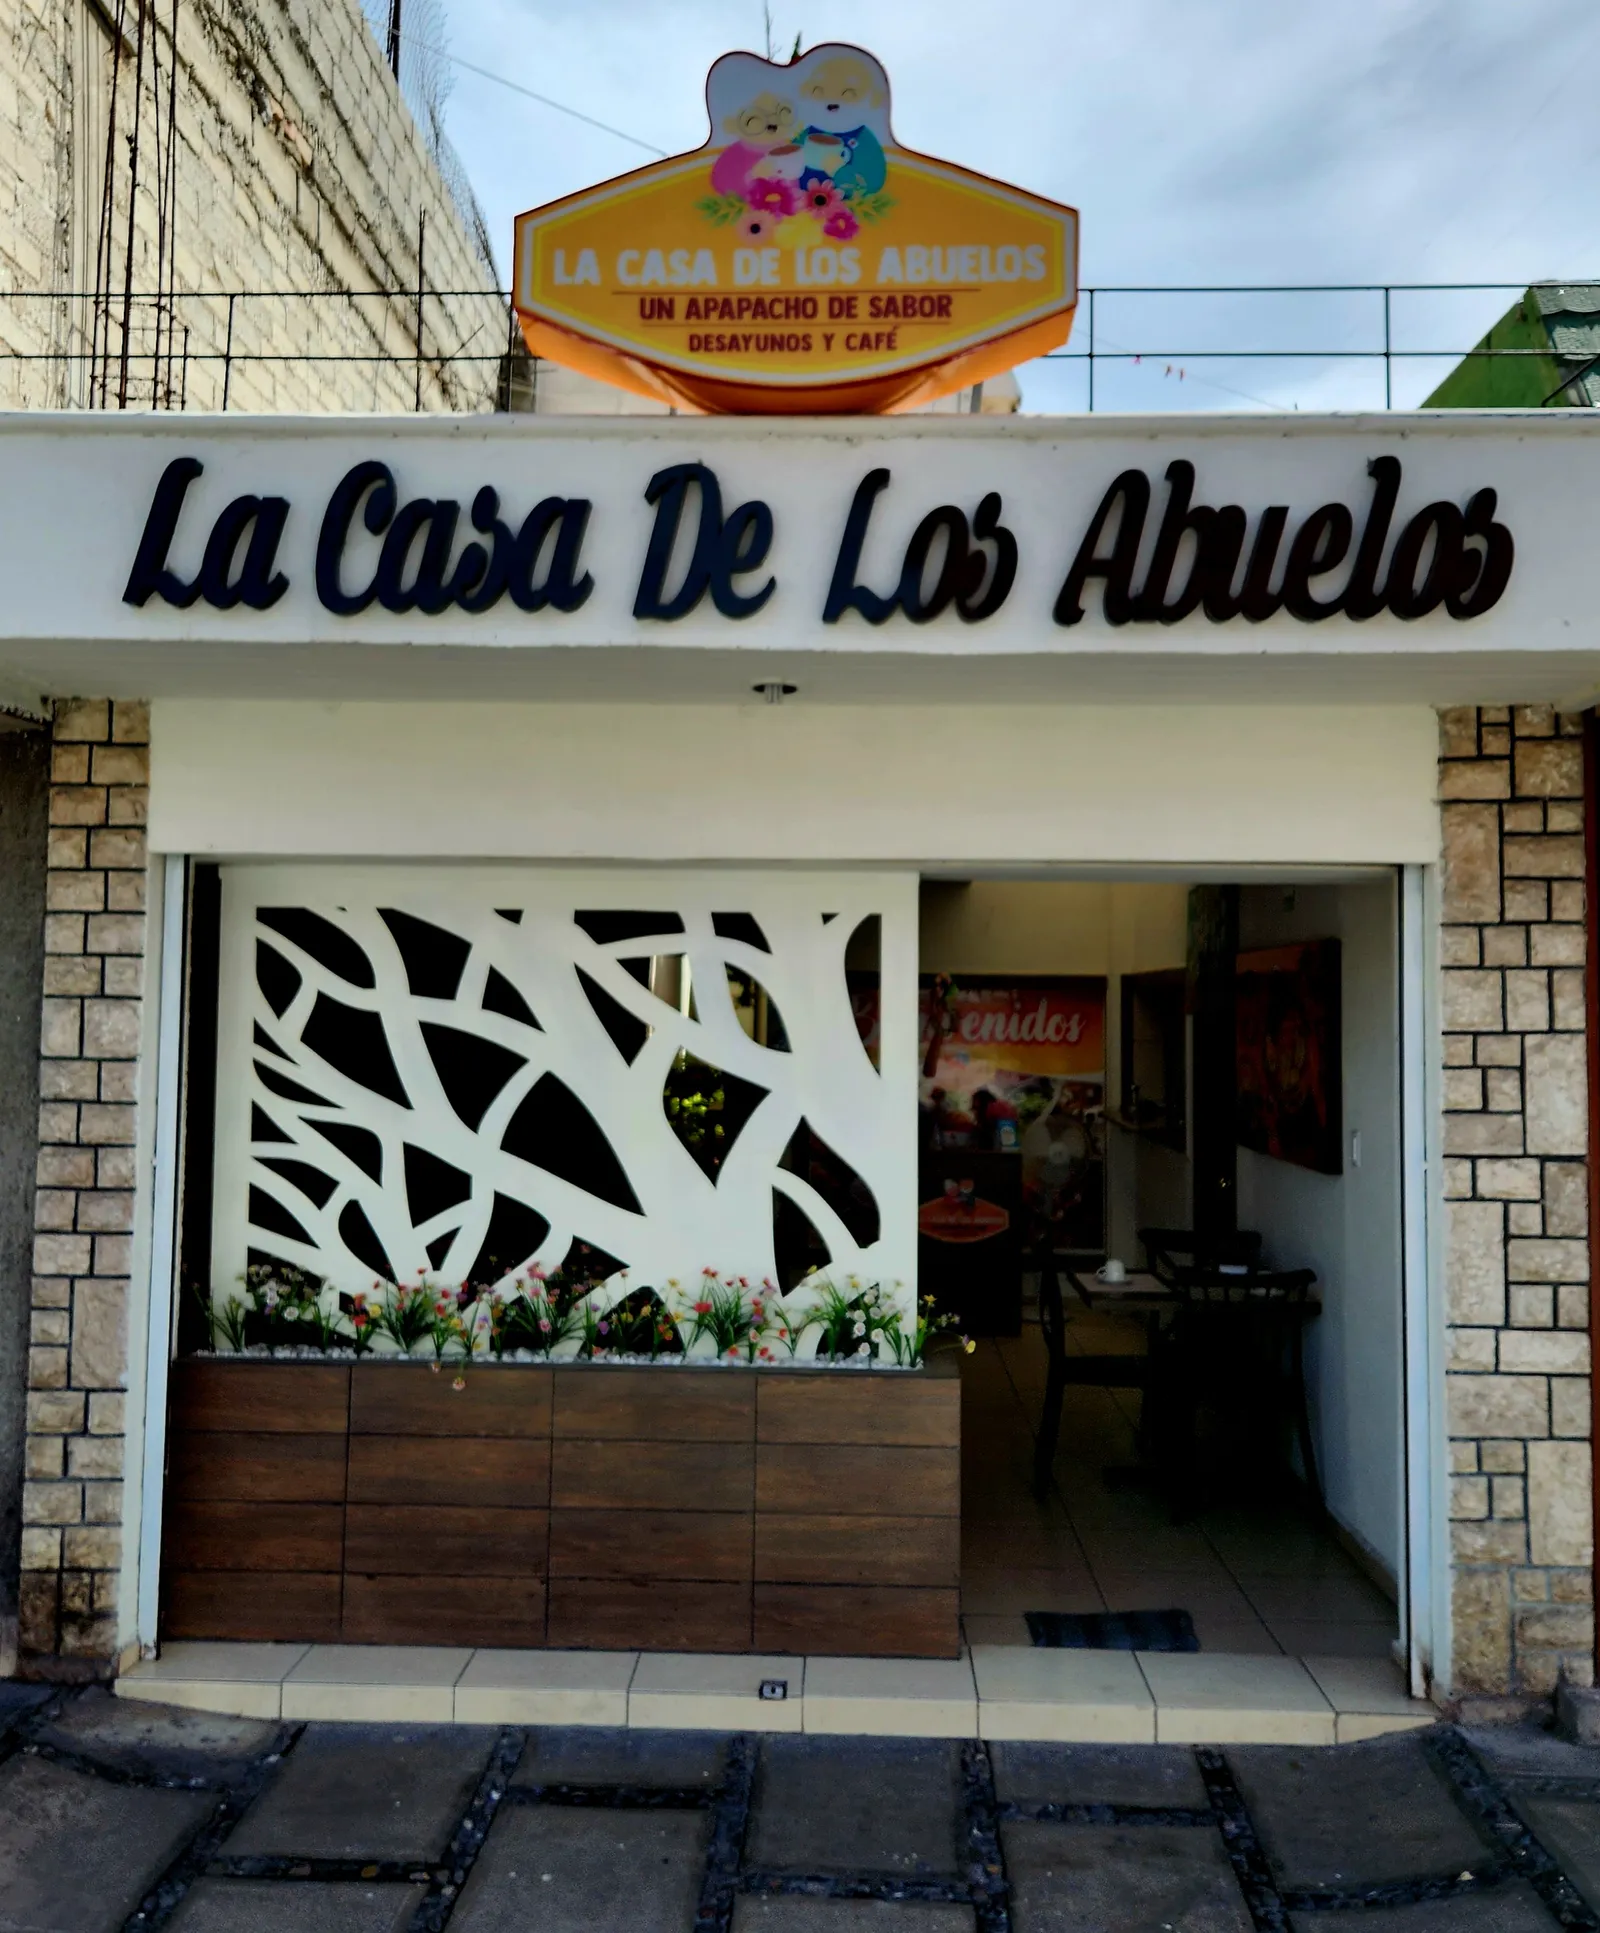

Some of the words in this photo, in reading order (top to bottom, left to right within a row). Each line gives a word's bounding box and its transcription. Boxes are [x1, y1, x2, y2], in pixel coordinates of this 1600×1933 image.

[553, 247, 602, 286] LA
[616, 247, 718, 286] CASA
[732, 247, 781, 286] DE
[794, 245, 862, 285] LOS
[876, 243, 1047, 284] ABUELOS
[639, 297, 675, 321] UN
[685, 296, 818, 321] APAPACHO
[828, 296, 859, 320] DE
[869, 294, 953, 319] SABOR
[688, 333, 813, 353] DESAYUNOS
[823, 333, 835, 352] Y
[845, 323, 899, 351] CAFÉ
[122, 456, 291, 610] La
[315, 460, 595, 616] Casa
[633, 460, 777, 621] De
[822, 467, 1018, 624] Los
[1052, 454, 1515, 627] Abuelos
